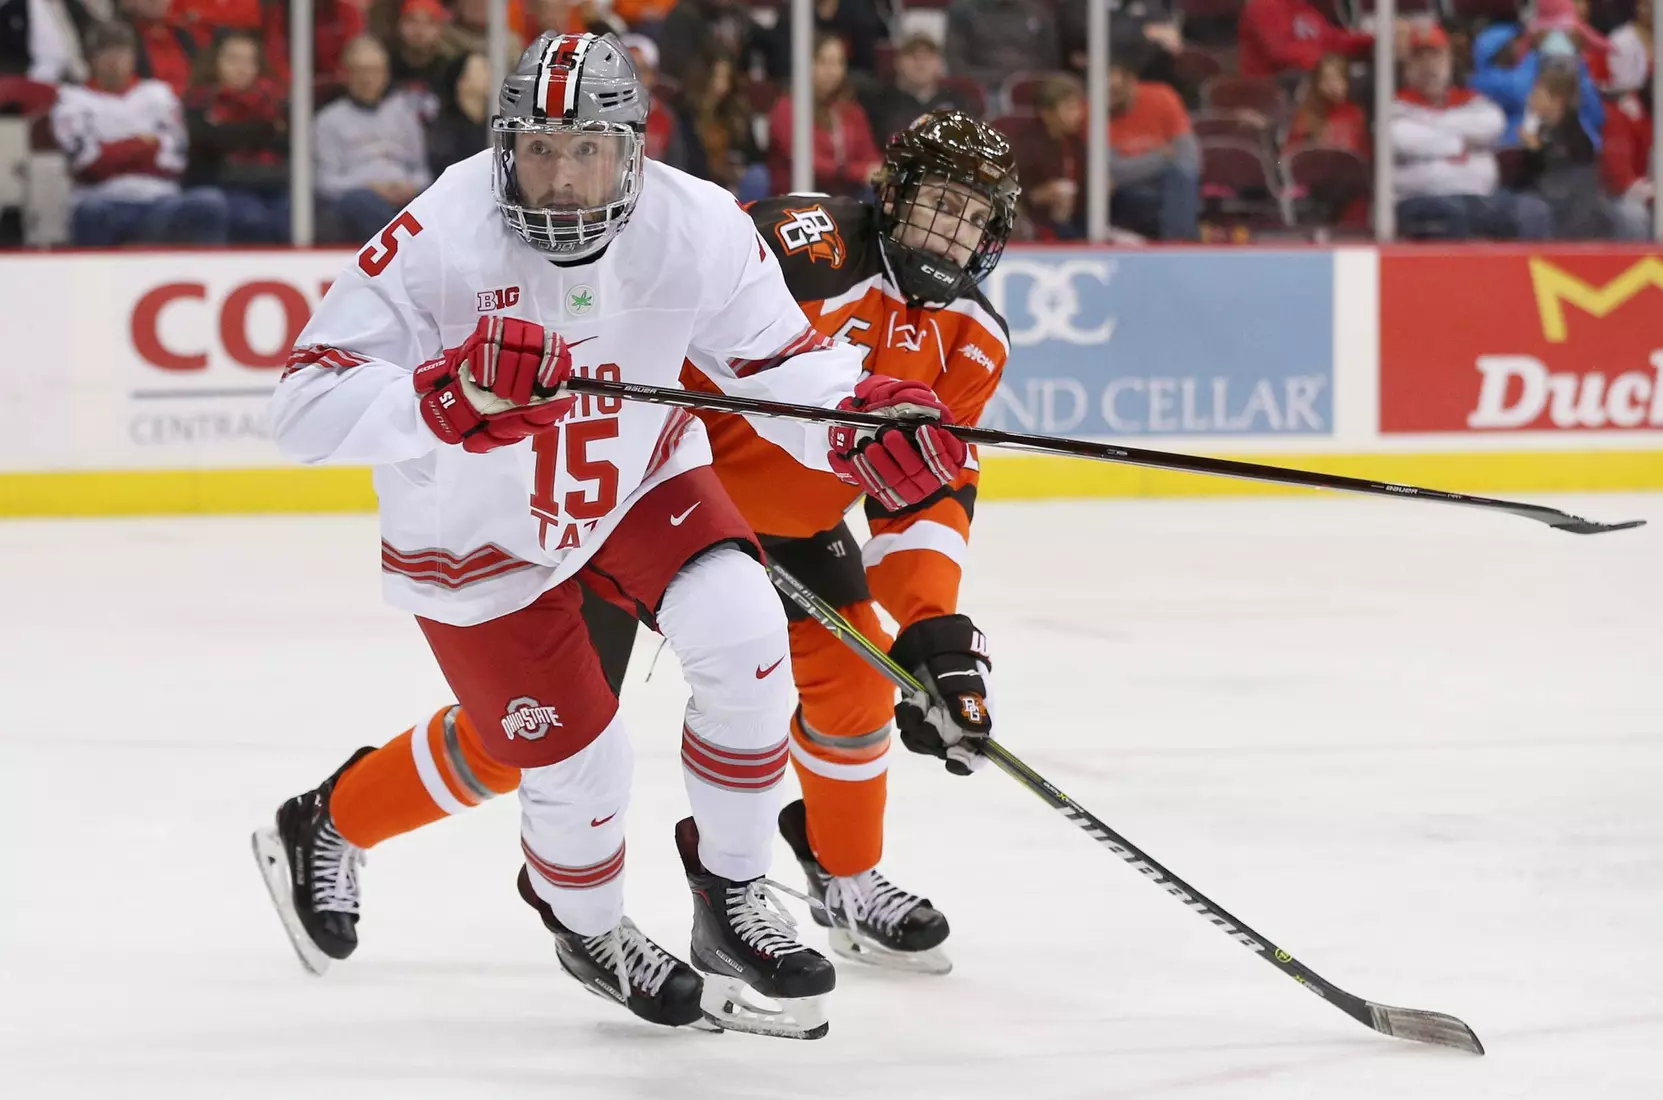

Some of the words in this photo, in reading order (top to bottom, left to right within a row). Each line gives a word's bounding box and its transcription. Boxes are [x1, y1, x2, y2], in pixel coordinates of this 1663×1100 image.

[546, 50, 579, 71] 15
[920, 263, 954, 285] CCM
[131, 279, 334, 374] CO
[1102, 376, 1325, 433] CELLAR
[529, 417, 619, 520] 15
